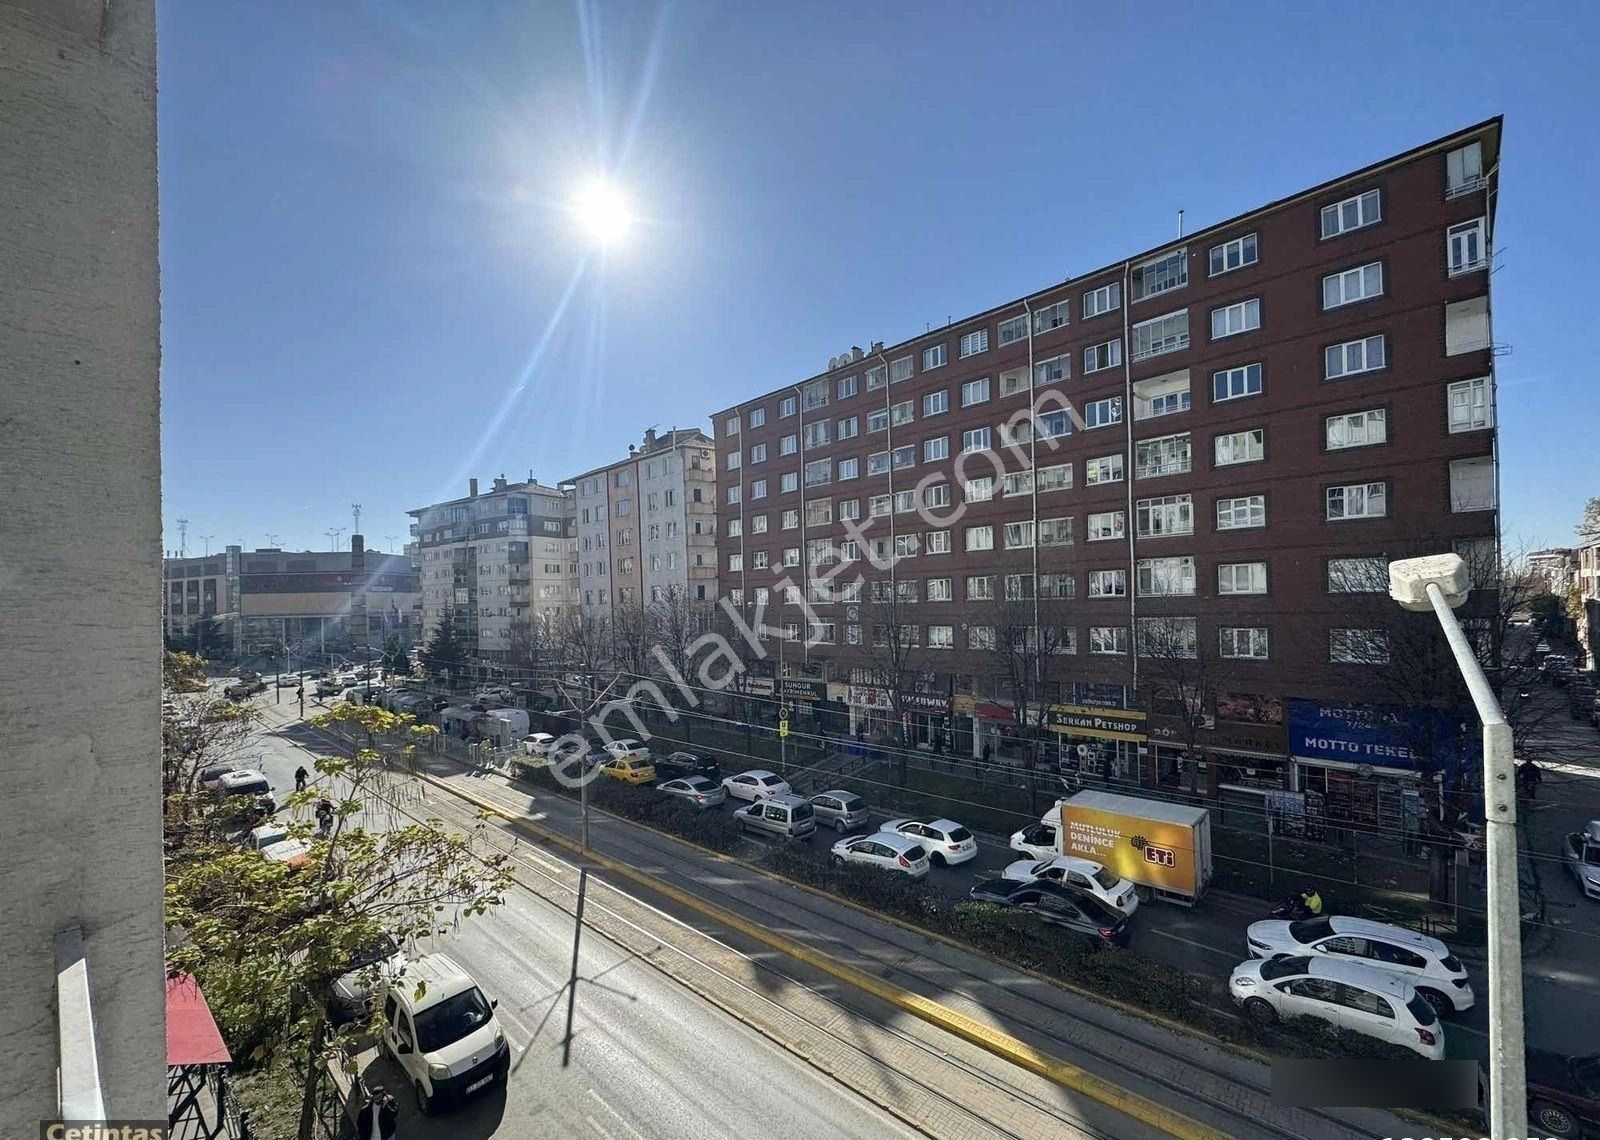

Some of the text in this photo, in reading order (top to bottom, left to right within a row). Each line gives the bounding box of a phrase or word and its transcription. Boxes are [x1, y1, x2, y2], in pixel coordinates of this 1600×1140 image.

[1056, 713, 1137, 732] SERKAN PETSHOP
[1305, 737, 1359, 753] MOTTO
[1070, 821, 1121, 839] MUTLULUK
[1070, 831, 1115, 849] DENİNCE
